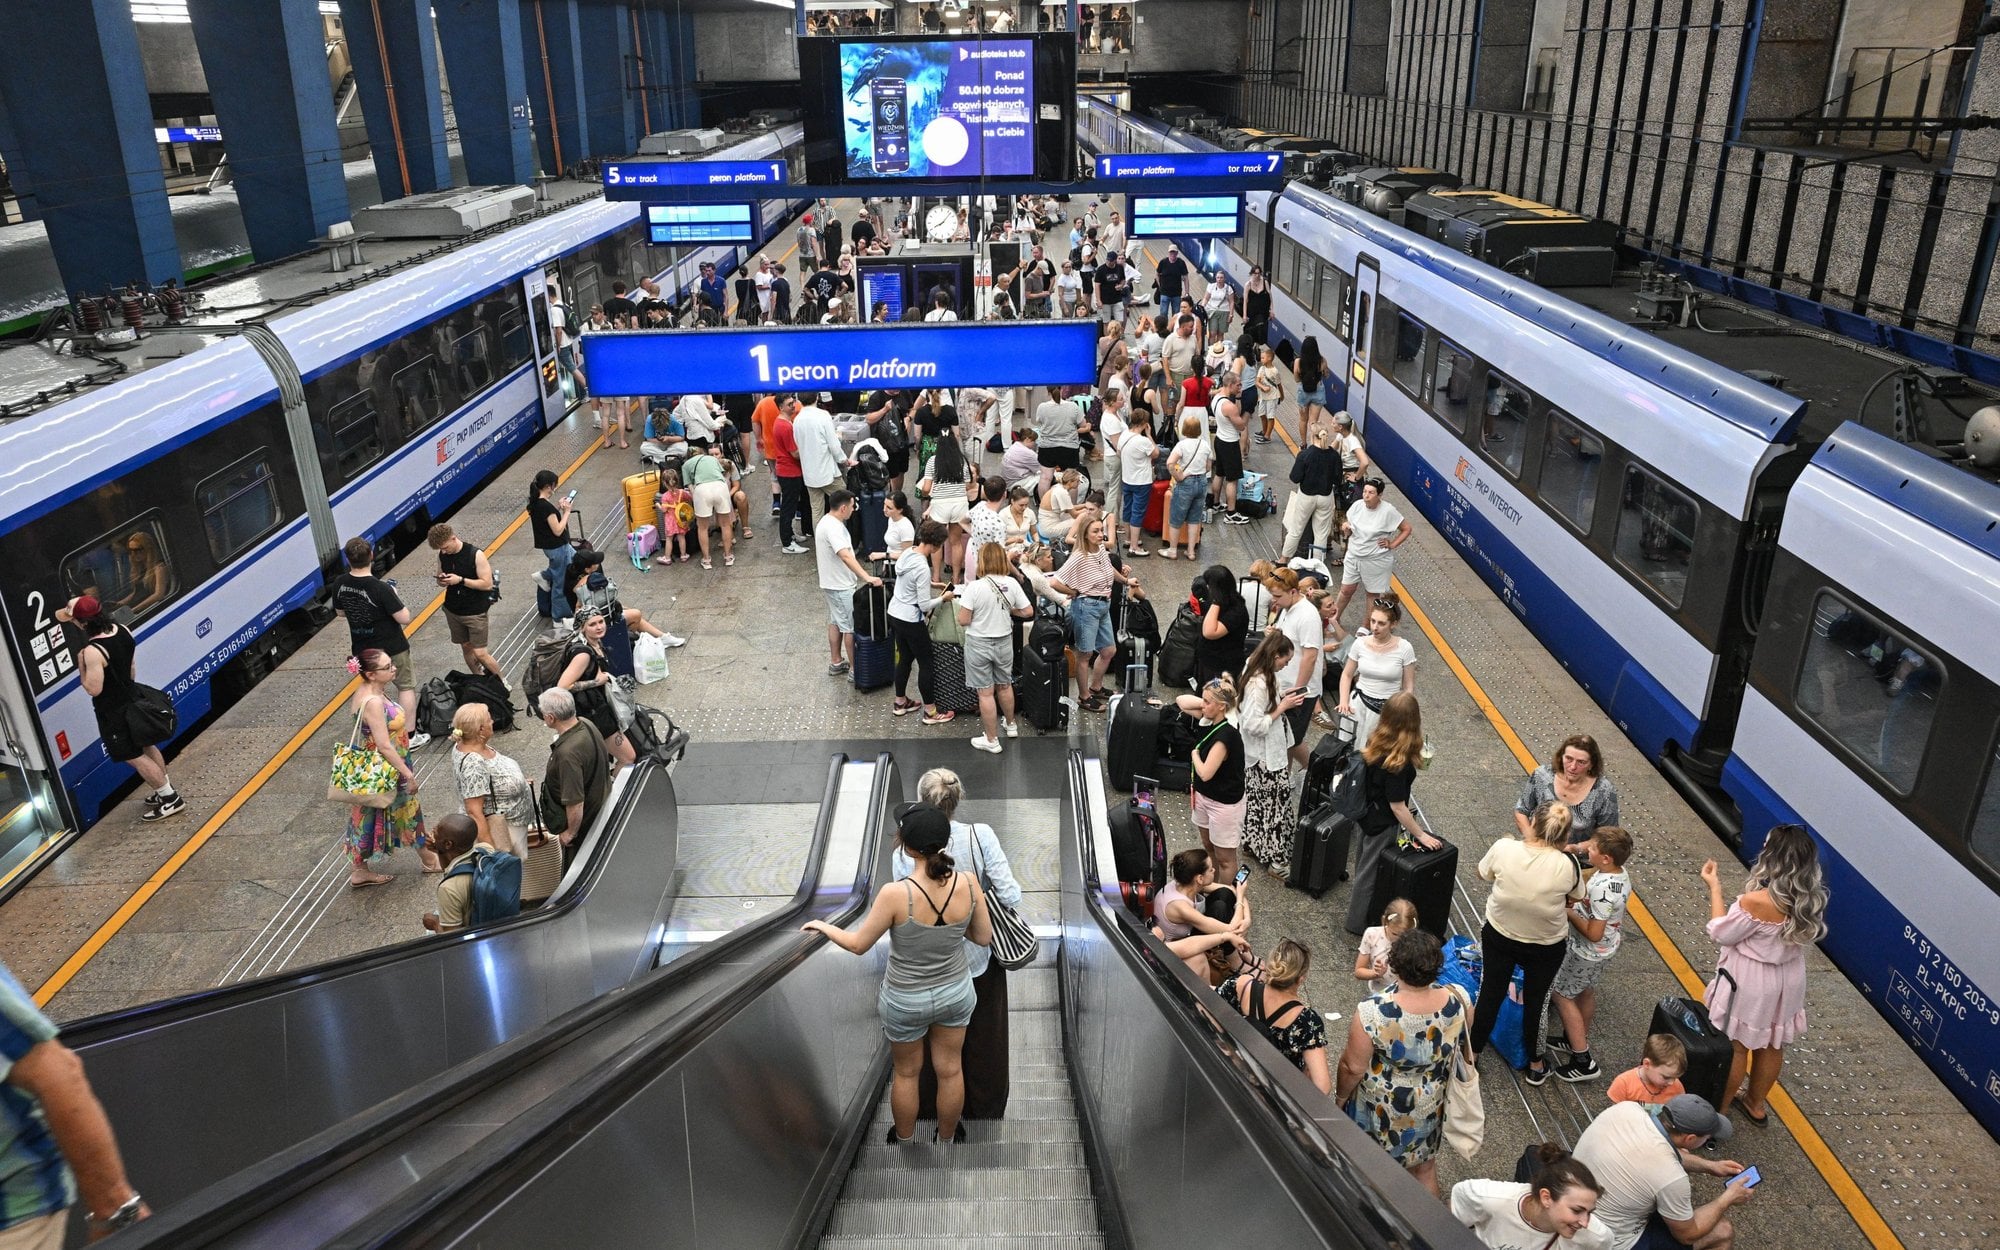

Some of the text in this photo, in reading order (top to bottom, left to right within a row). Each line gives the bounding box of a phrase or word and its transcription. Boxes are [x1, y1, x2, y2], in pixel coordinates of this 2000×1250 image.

[970, 49, 1025, 58] audioteka klub
[995, 70, 1025, 80] Ponad
[993, 85, 1025, 94] dobrze
[983, 127, 1025, 137] na Ciebie
[608, 167, 620, 184] 5
[639, 174, 658, 183] track
[709, 174, 732, 184] peron
[734, 172, 766, 183] platform
[770, 163, 780, 181] 1
[1102, 155, 1280, 176] 1 peron platform tor track 7
[749, 344, 937, 385] 1 peron platform
[456, 427, 468, 446] PKP
[468, 408, 494, 437] INTERCITY
[1475, 478, 1490, 494] PKP
[1488, 490, 1523, 526] INTERCITY
[27, 590, 51, 632] 2
[198, 620, 212, 637] PKP
[174, 678, 189, 696] 150
[188, 662, 210, 685] 335-9
[1903, 925, 2000, 1025] 94 51 2 150 203-9
[1915, 964, 1968, 1021] PL-PKPIC
[1900, 1004, 1912, 1020] 56
